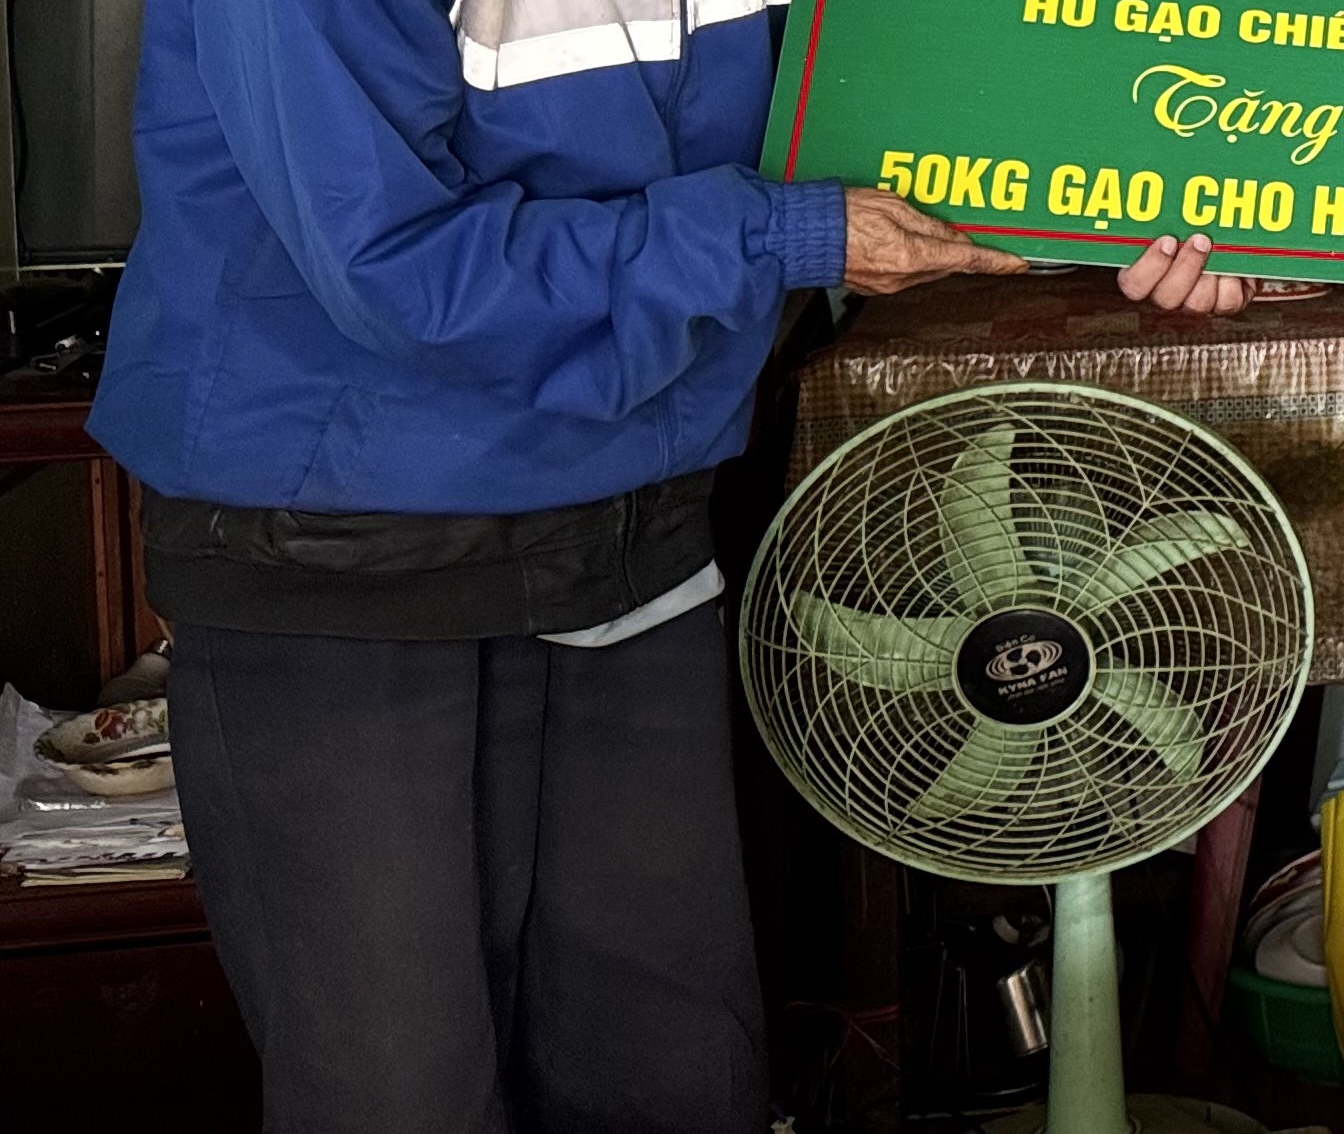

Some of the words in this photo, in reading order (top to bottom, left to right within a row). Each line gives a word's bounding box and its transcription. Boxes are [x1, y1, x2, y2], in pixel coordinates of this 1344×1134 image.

[1132, 64, 1344, 165] Tặng
[878, 150, 1030, 211] 50KG
[1047, 164, 1165, 231] GẠO
[1181, 175, 1295, 238] CHO
